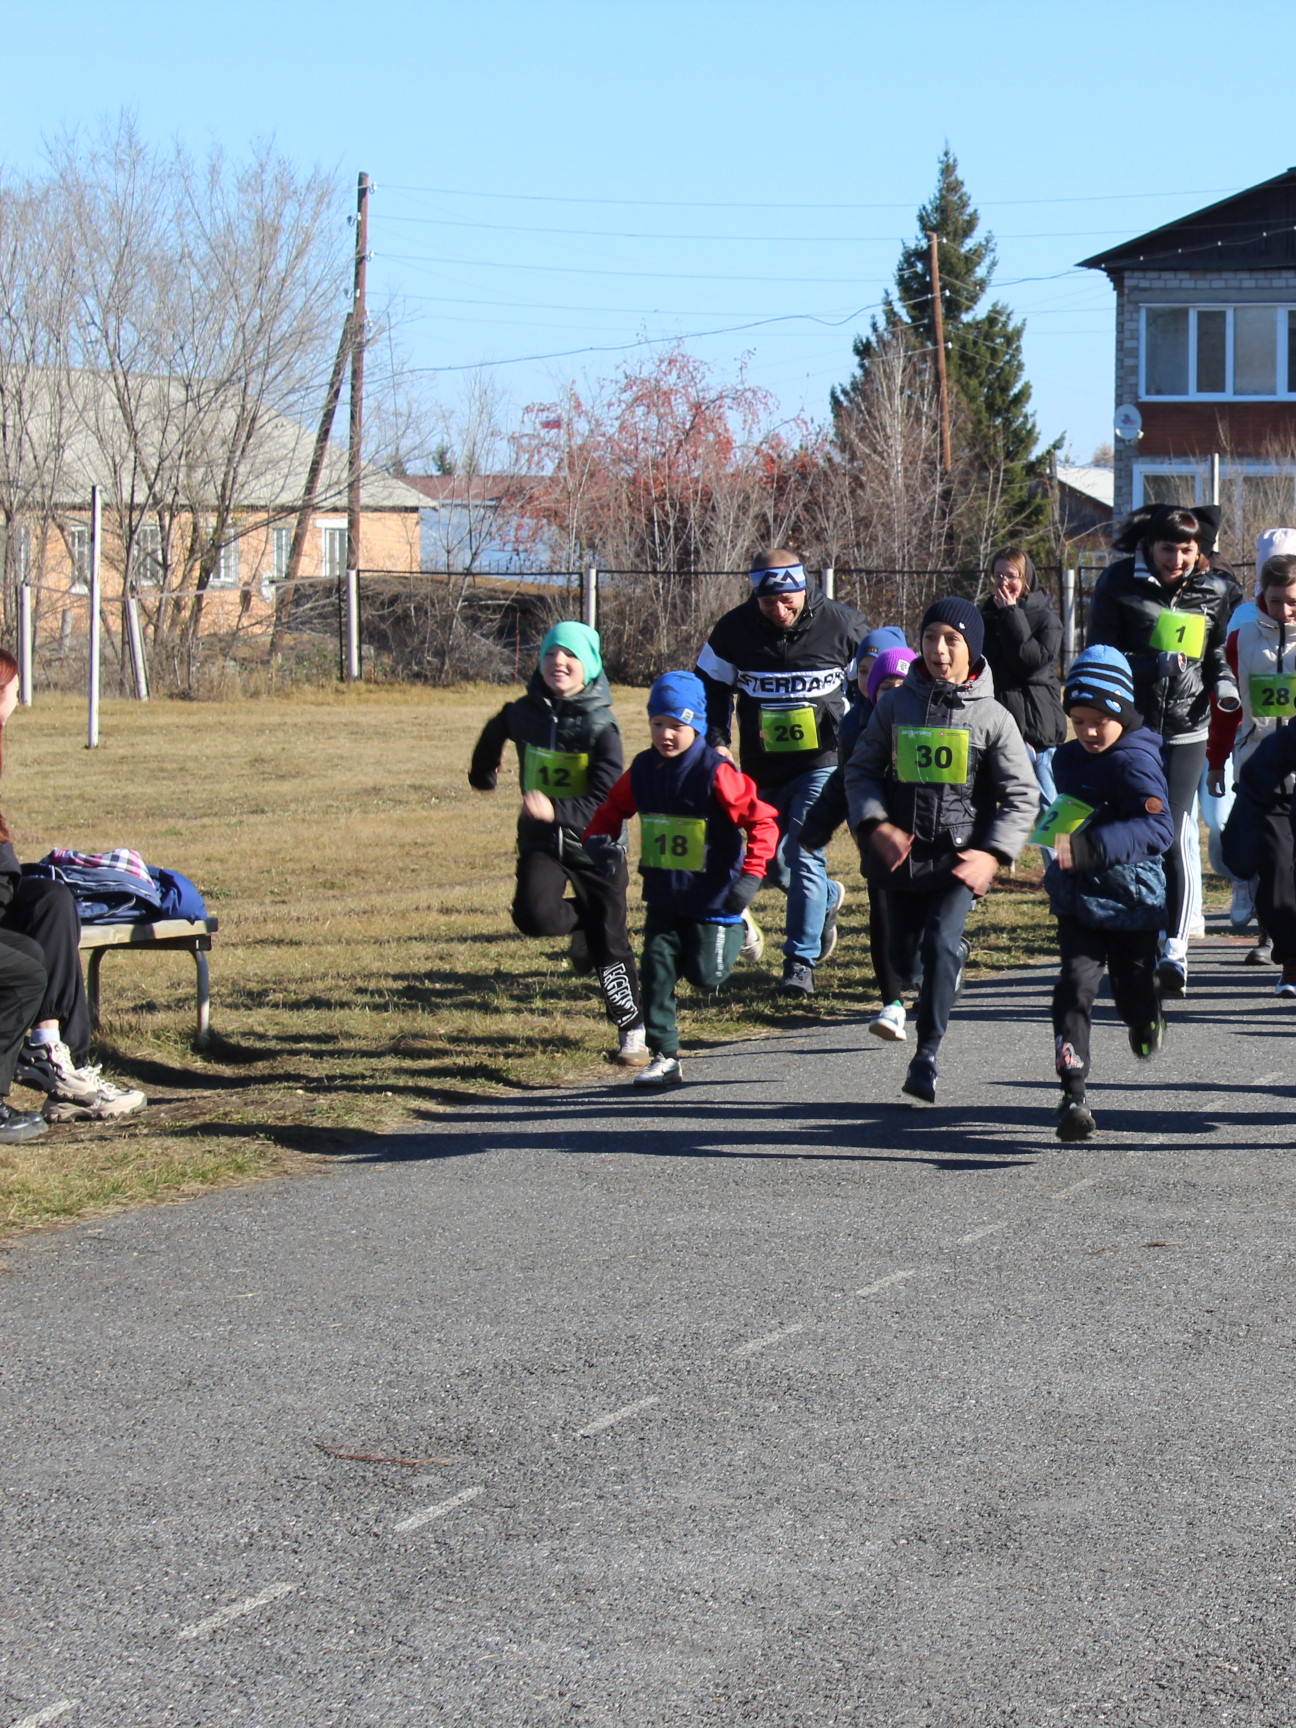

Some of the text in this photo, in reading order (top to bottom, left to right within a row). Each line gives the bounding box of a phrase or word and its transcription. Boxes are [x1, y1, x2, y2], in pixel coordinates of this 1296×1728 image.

[1175, 625, 1187, 644] 1
[1261, 687, 1290, 707] 28
[774, 723, 805, 743] 26
[915, 744, 953, 769] 30
[538, 765, 571, 787] 12
[655, 833, 688, 857] 18
